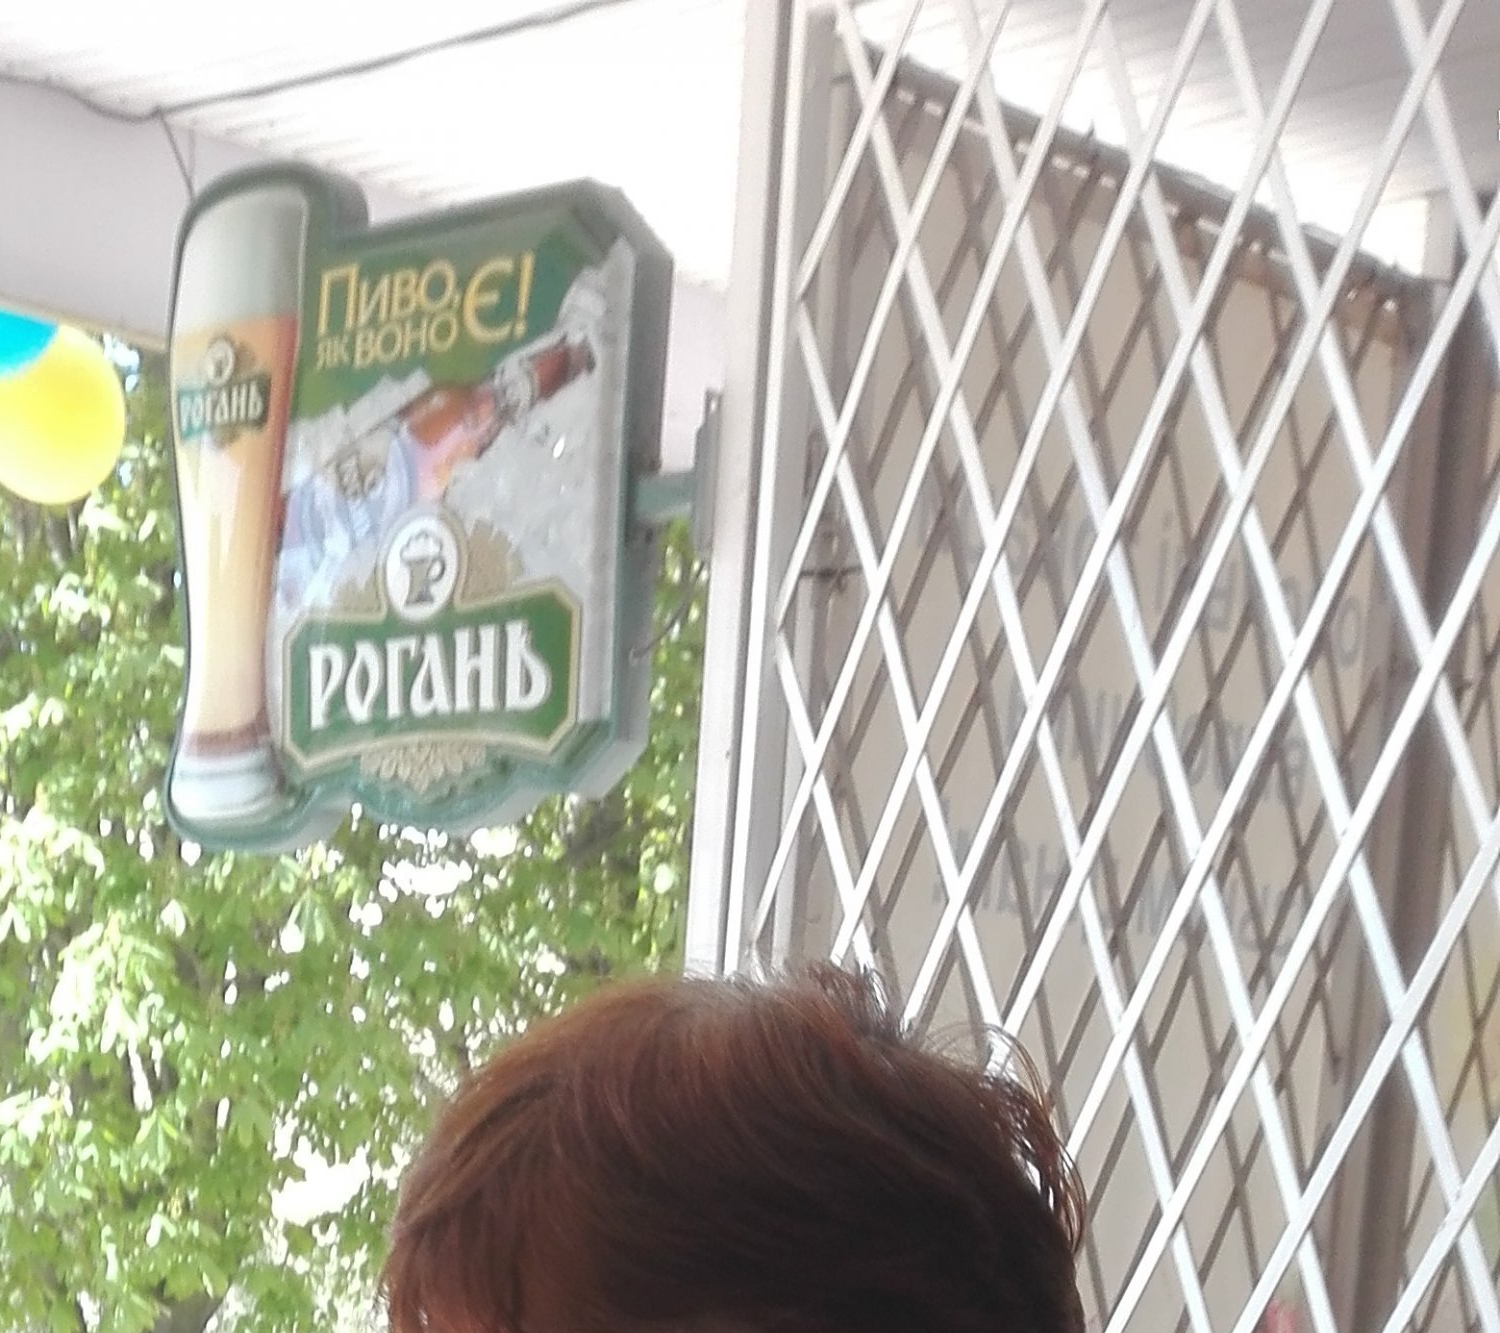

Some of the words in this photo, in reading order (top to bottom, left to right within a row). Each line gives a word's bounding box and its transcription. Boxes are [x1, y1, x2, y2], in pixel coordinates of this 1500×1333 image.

[352, 311, 458, 370] ВОНО
[179, 379, 265, 434] РОГАНЬ
[308, 619, 553, 731] РОГАНЬ
